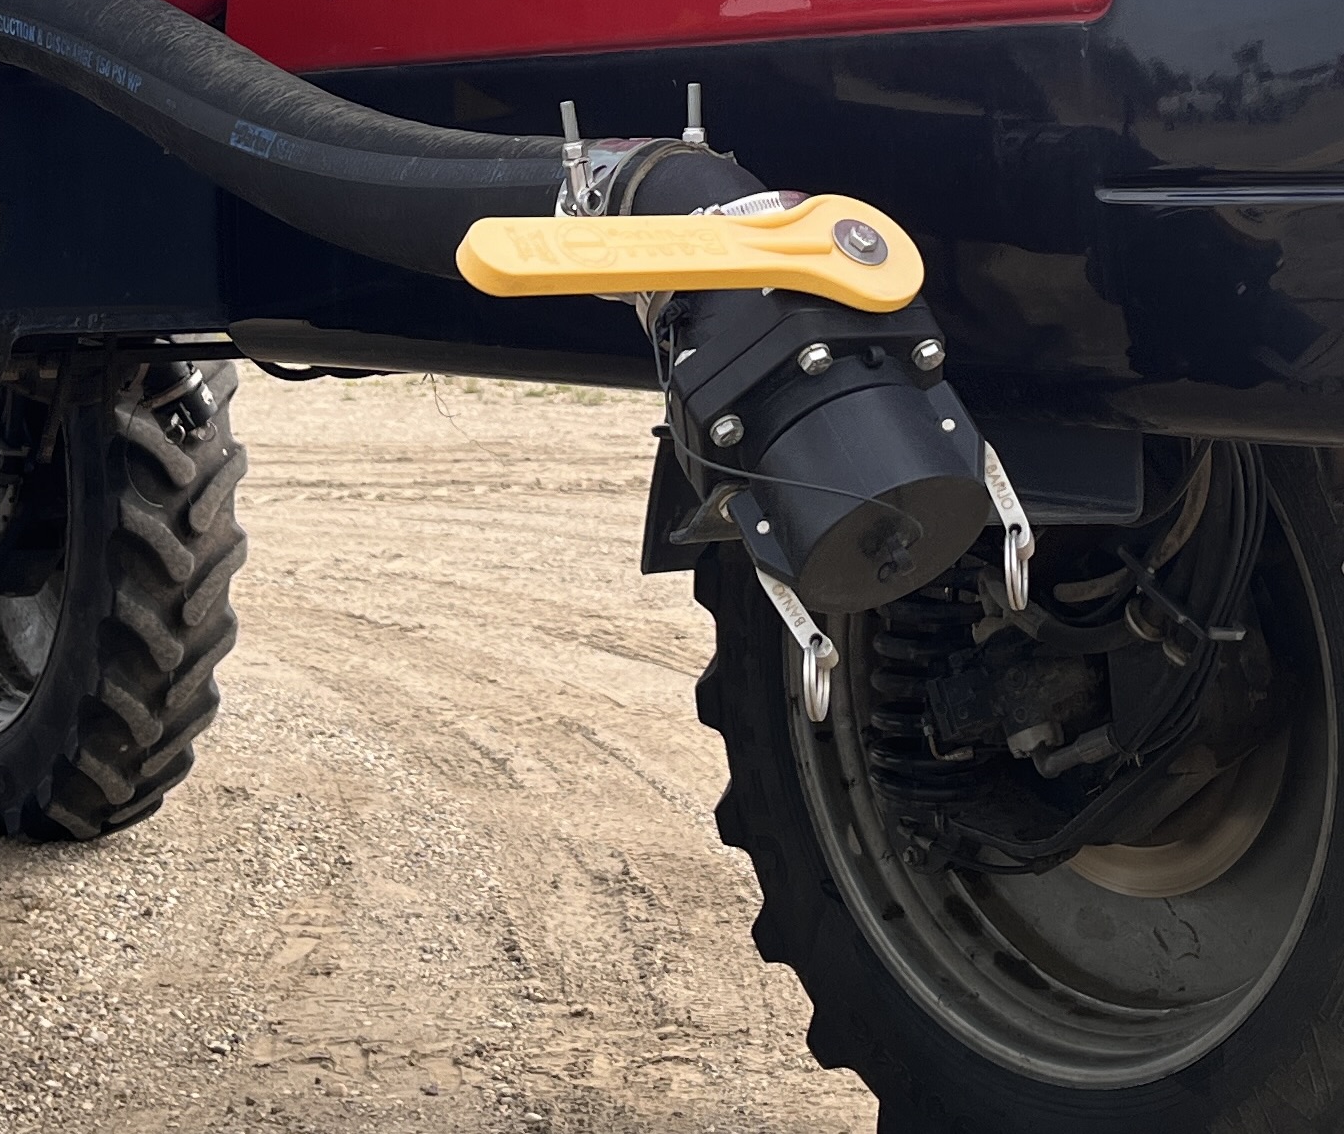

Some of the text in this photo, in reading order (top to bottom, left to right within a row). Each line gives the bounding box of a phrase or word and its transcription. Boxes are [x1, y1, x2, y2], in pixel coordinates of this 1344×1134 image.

[45, 31, 95, 68] DISCHARGE
[111, 63, 128, 88] PSI
[771, 582, 807, 629] BANJO
